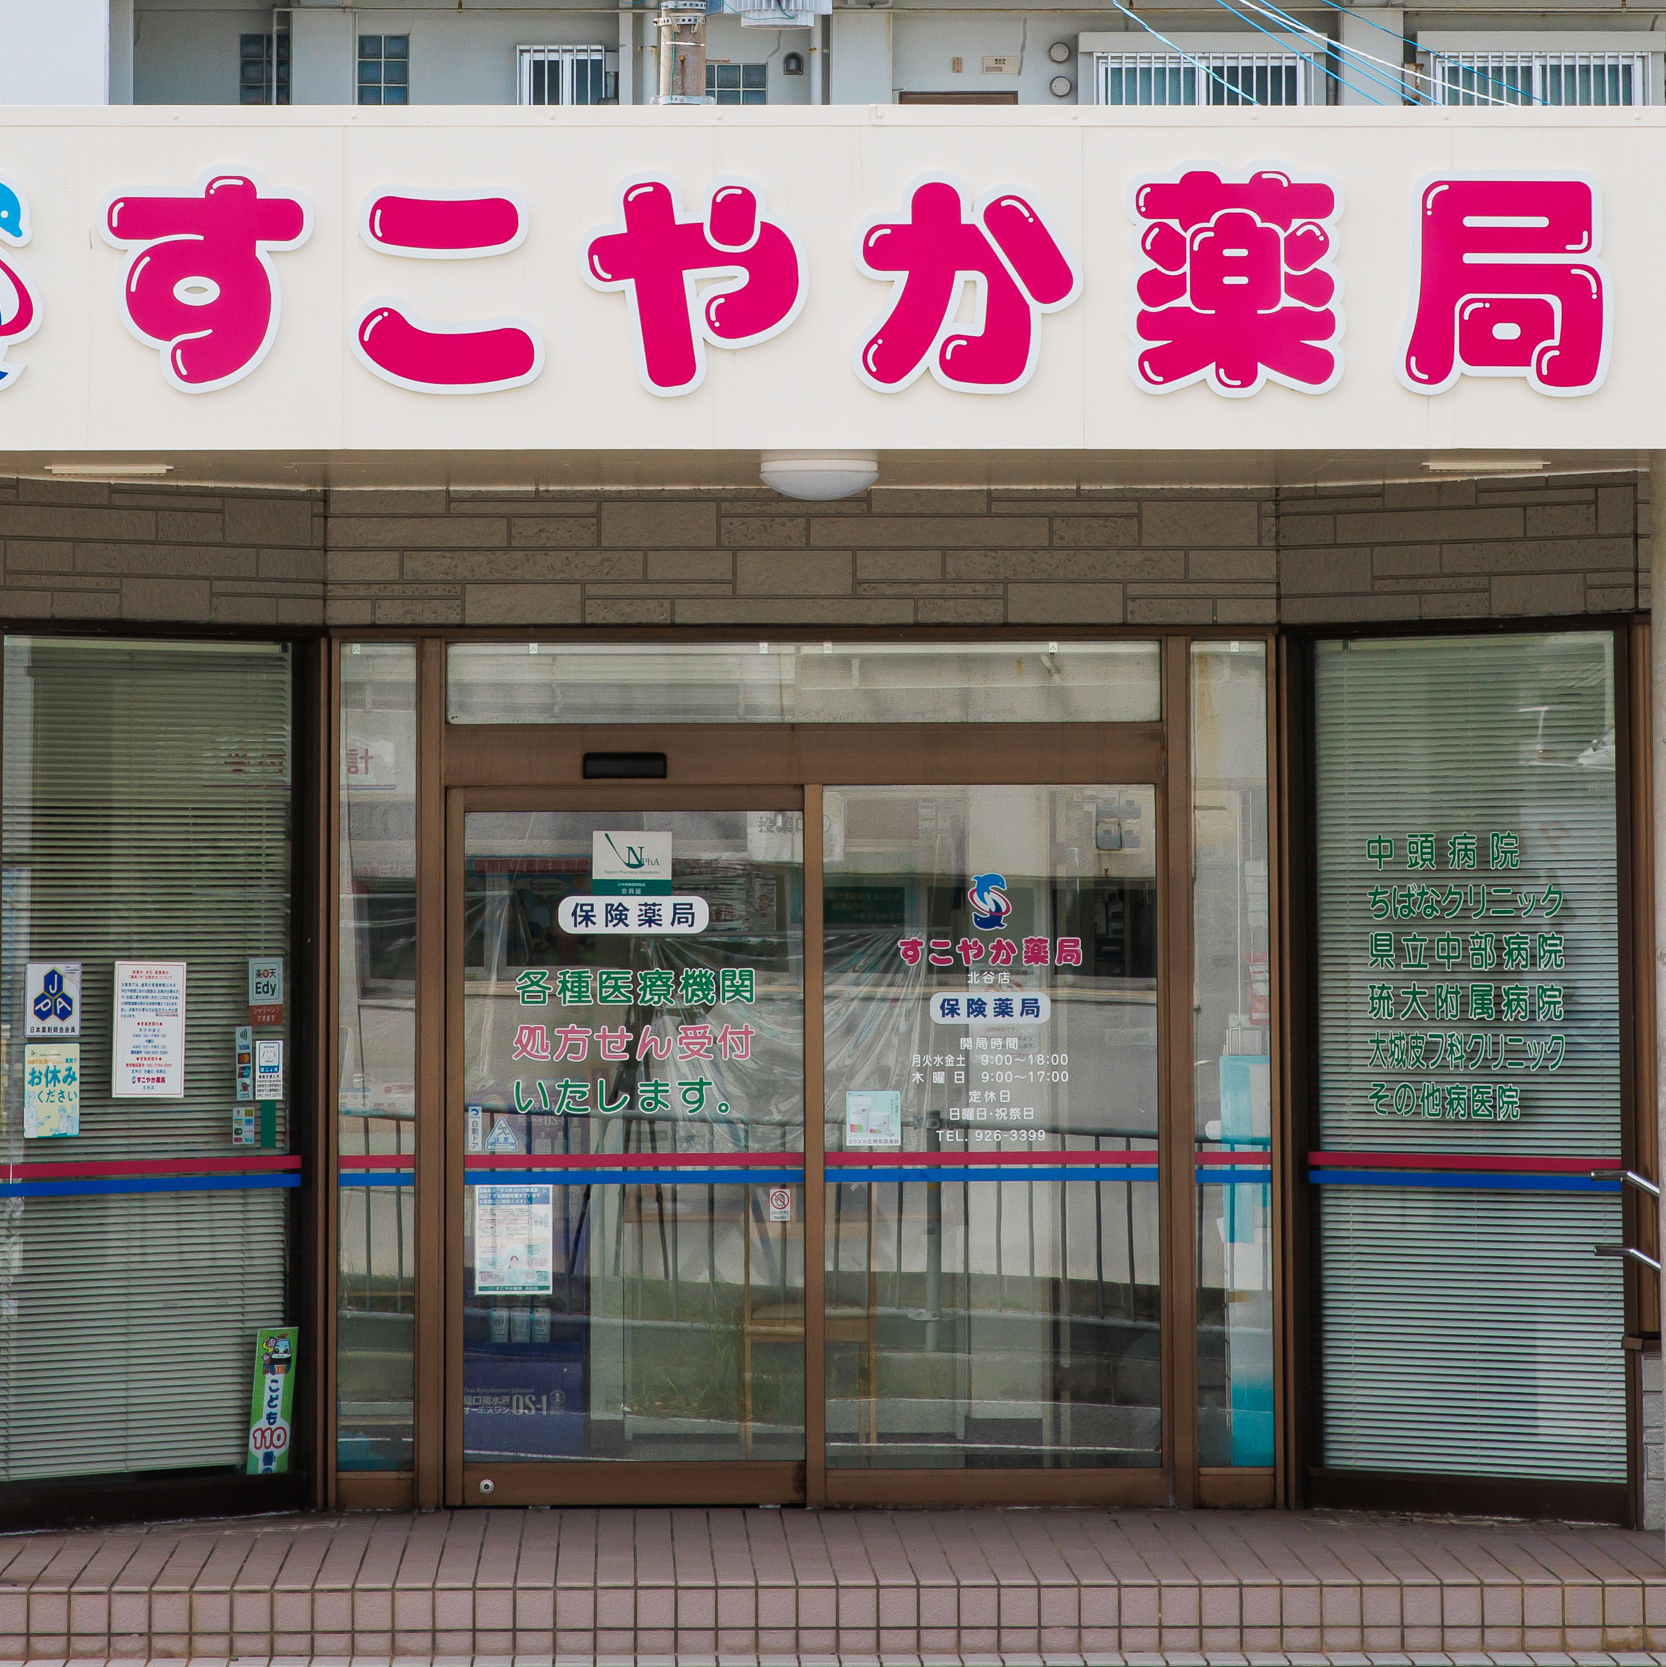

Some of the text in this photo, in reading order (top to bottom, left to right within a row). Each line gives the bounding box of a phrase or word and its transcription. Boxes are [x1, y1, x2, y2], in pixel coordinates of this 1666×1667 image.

[101, 170, 1613, 398] すこやか薬局
[1366, 831, 1520, 871] 中頭病院
[1367, 883, 1563, 920] ちばなクリニック
[571, 902, 696, 928] 保険薬局
[897, 936, 1083, 967] すこやか薬局
[1367, 931, 1565, 971] 県立中部病院
[255, 980, 277, 997] Edy
[515, 968, 756, 1006] 各種医療機関
[967, 971, 1011, 985] 北谷店
[939, 997, 1041, 1019] 保険薬局
[1367, 982, 1564, 1021] 琉大附属病院
[512, 1023, 756, 1062] 処方せん受付
[959, 1037, 1019, 1050] 開局時間
[1367, 1030, 1565, 1071] 大城皮フ科クリニック
[911, 1054, 966, 1068] 月火水金土
[27, 1064, 78, 1088] お休み
[911, 1071, 966, 1084] 木曜日
[37, 1089, 78, 1104] ください
[514, 1076, 732, 1115] いたします。
[968, 1090, 1011, 1103] 定休日
[1367, 1081, 1520, 1120] その他病医院
[936, 1129, 1046, 1142] TEL. 926-3399
[512, 1394, 548, 1416] OS-1
[252, 1426, 287, 1451] 110
